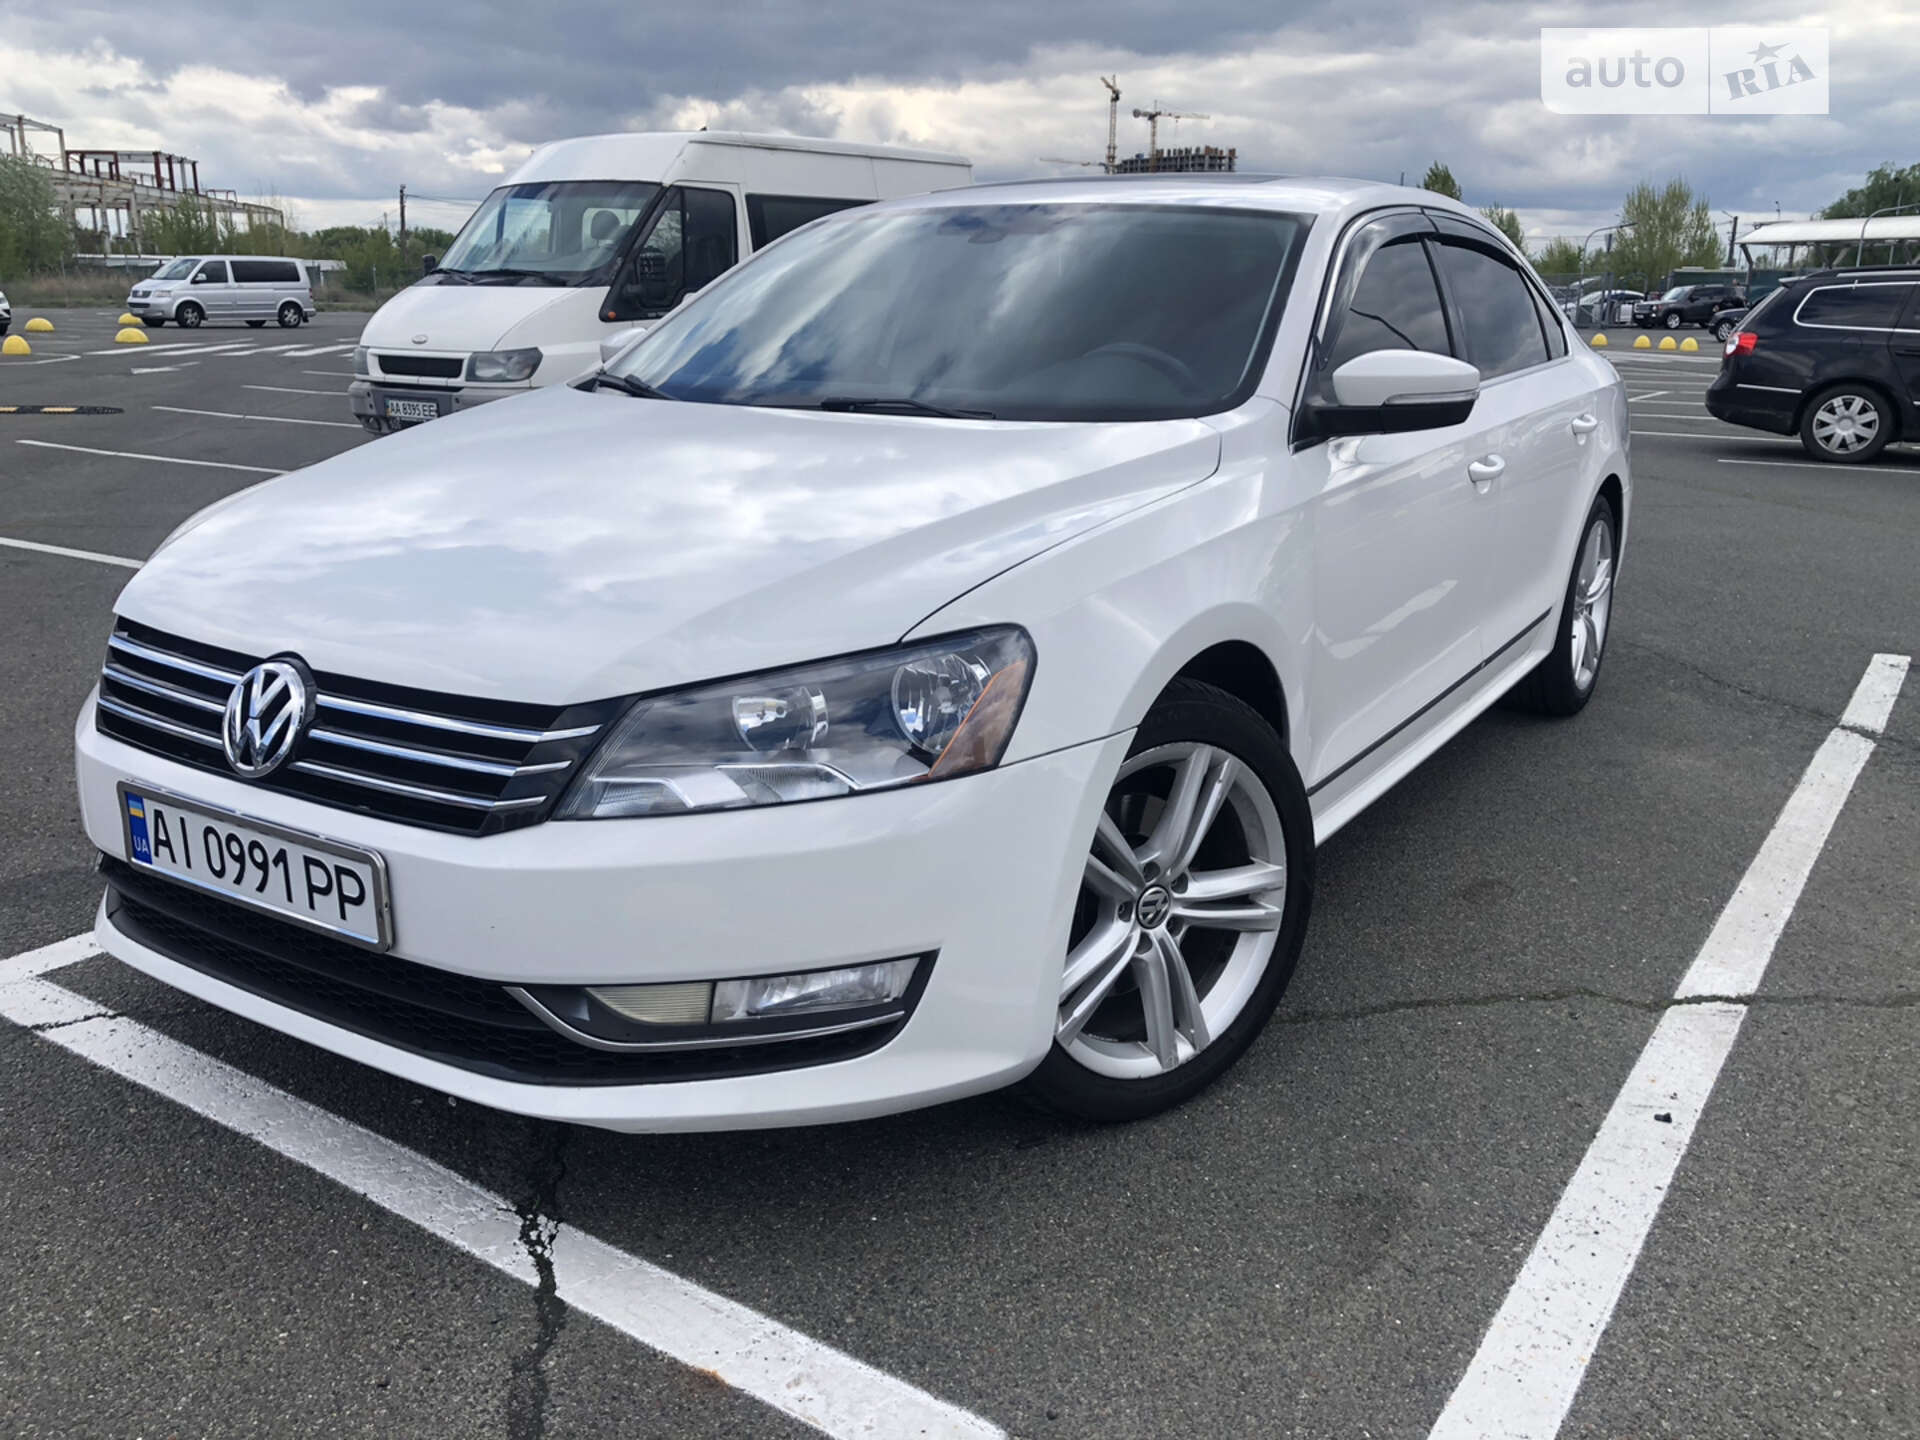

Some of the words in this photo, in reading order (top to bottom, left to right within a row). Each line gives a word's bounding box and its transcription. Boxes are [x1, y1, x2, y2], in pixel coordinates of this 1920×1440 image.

[422, 404, 436, 417] EE
[133, 835, 150, 856] UA
[153, 809, 192, 869] AI
[203, 825, 294, 904] 0991
[302, 854, 366, 921] PP
